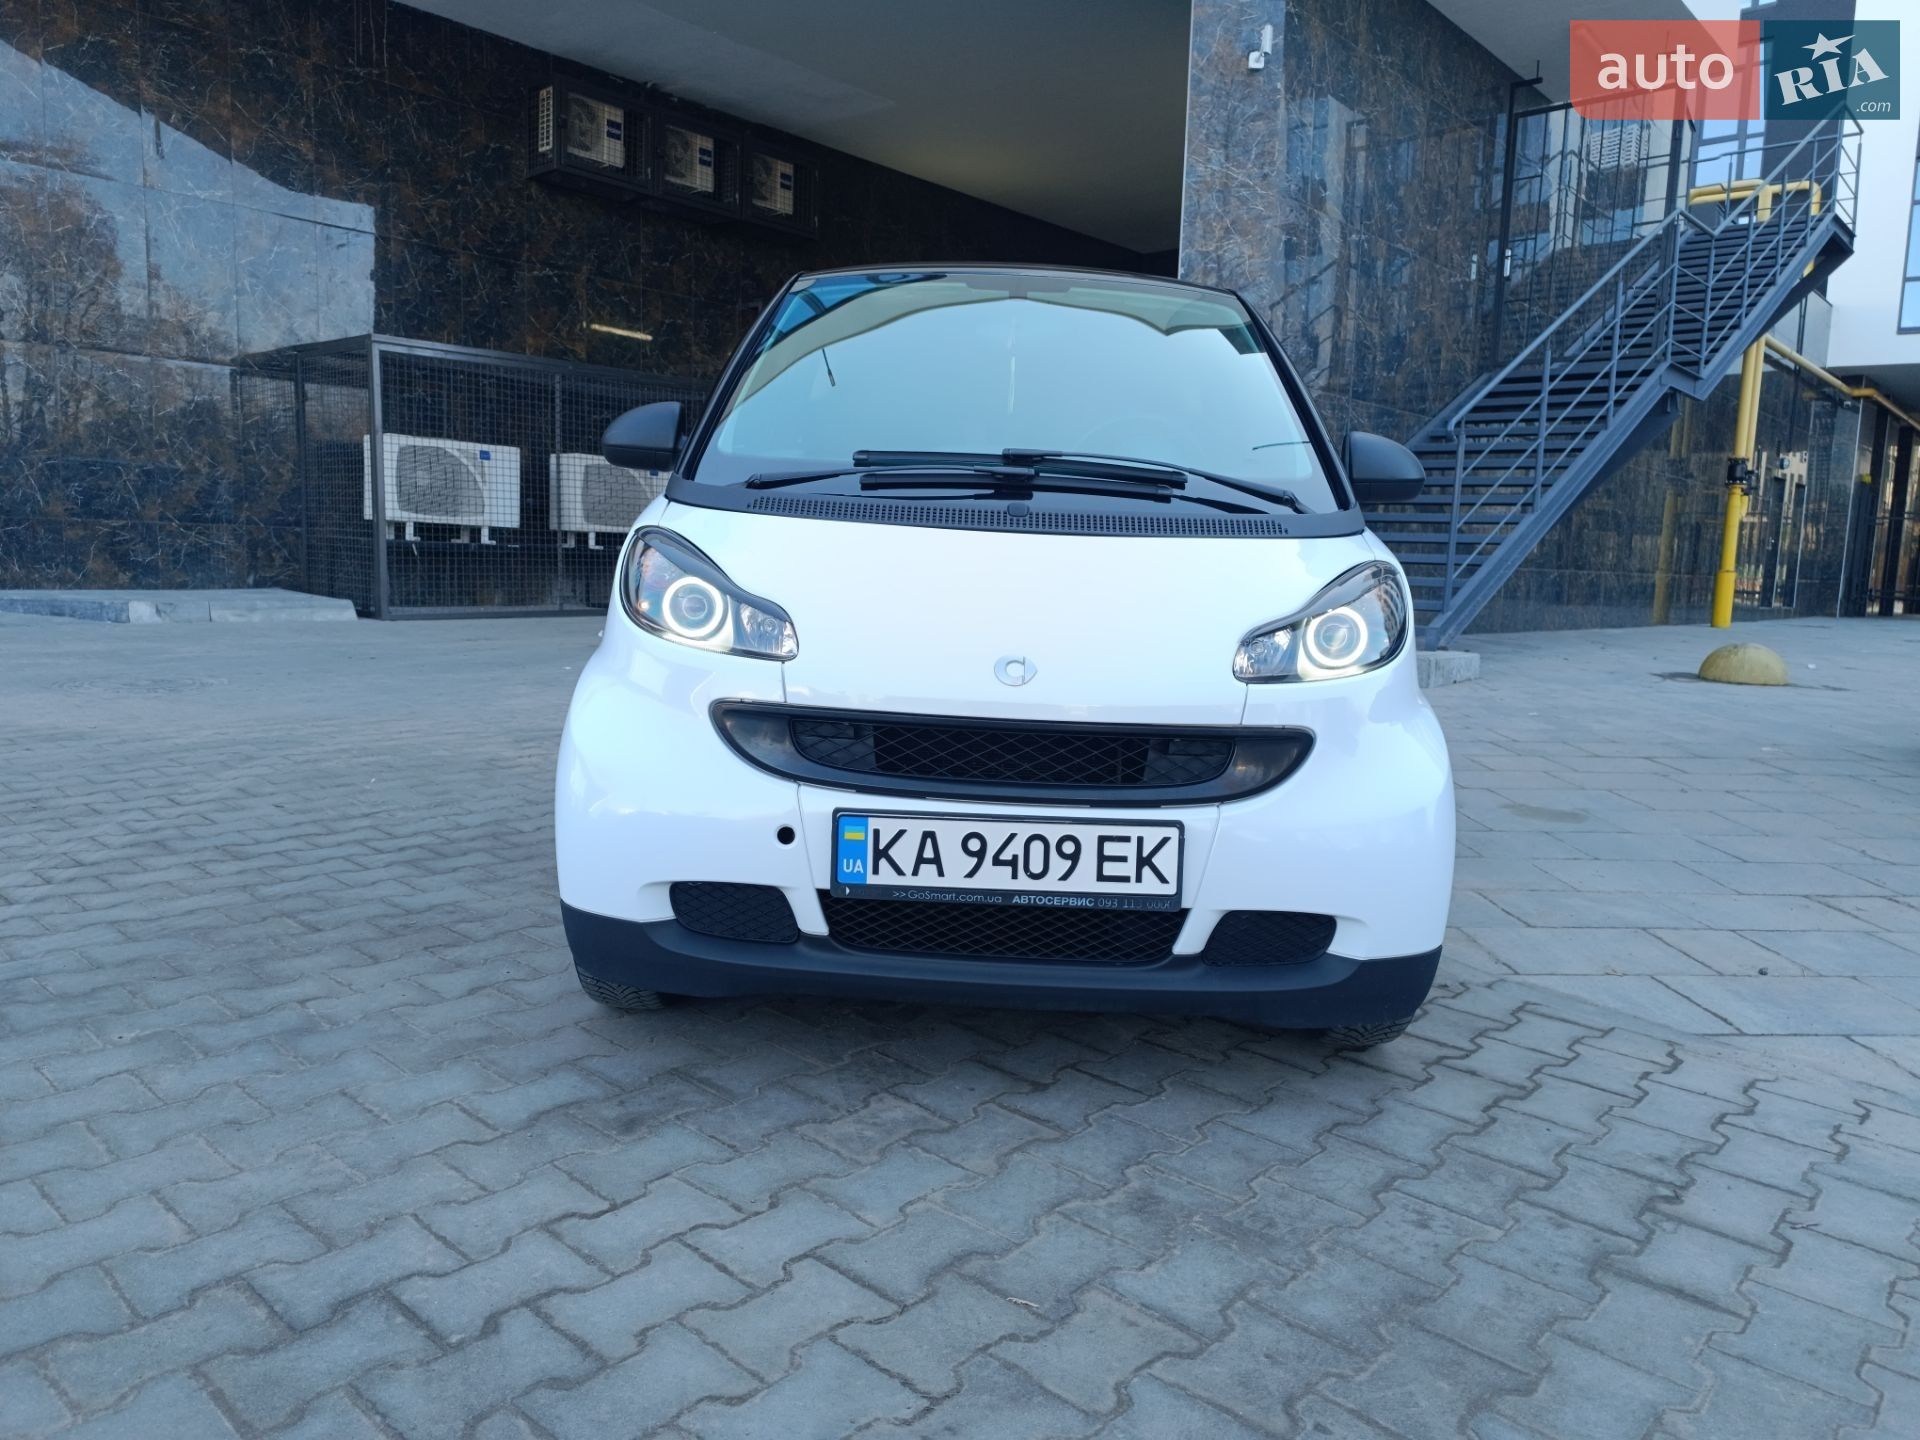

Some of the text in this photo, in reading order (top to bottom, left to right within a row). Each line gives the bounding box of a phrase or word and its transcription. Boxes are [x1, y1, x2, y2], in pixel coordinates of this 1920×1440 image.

[871, 828, 1173, 884] KA 9409 EK
[842, 858, 864, 873] UA
[1012, 895, 1095, 907] АВТОСЕРВИС
[1097, 898, 1118, 909] 093
